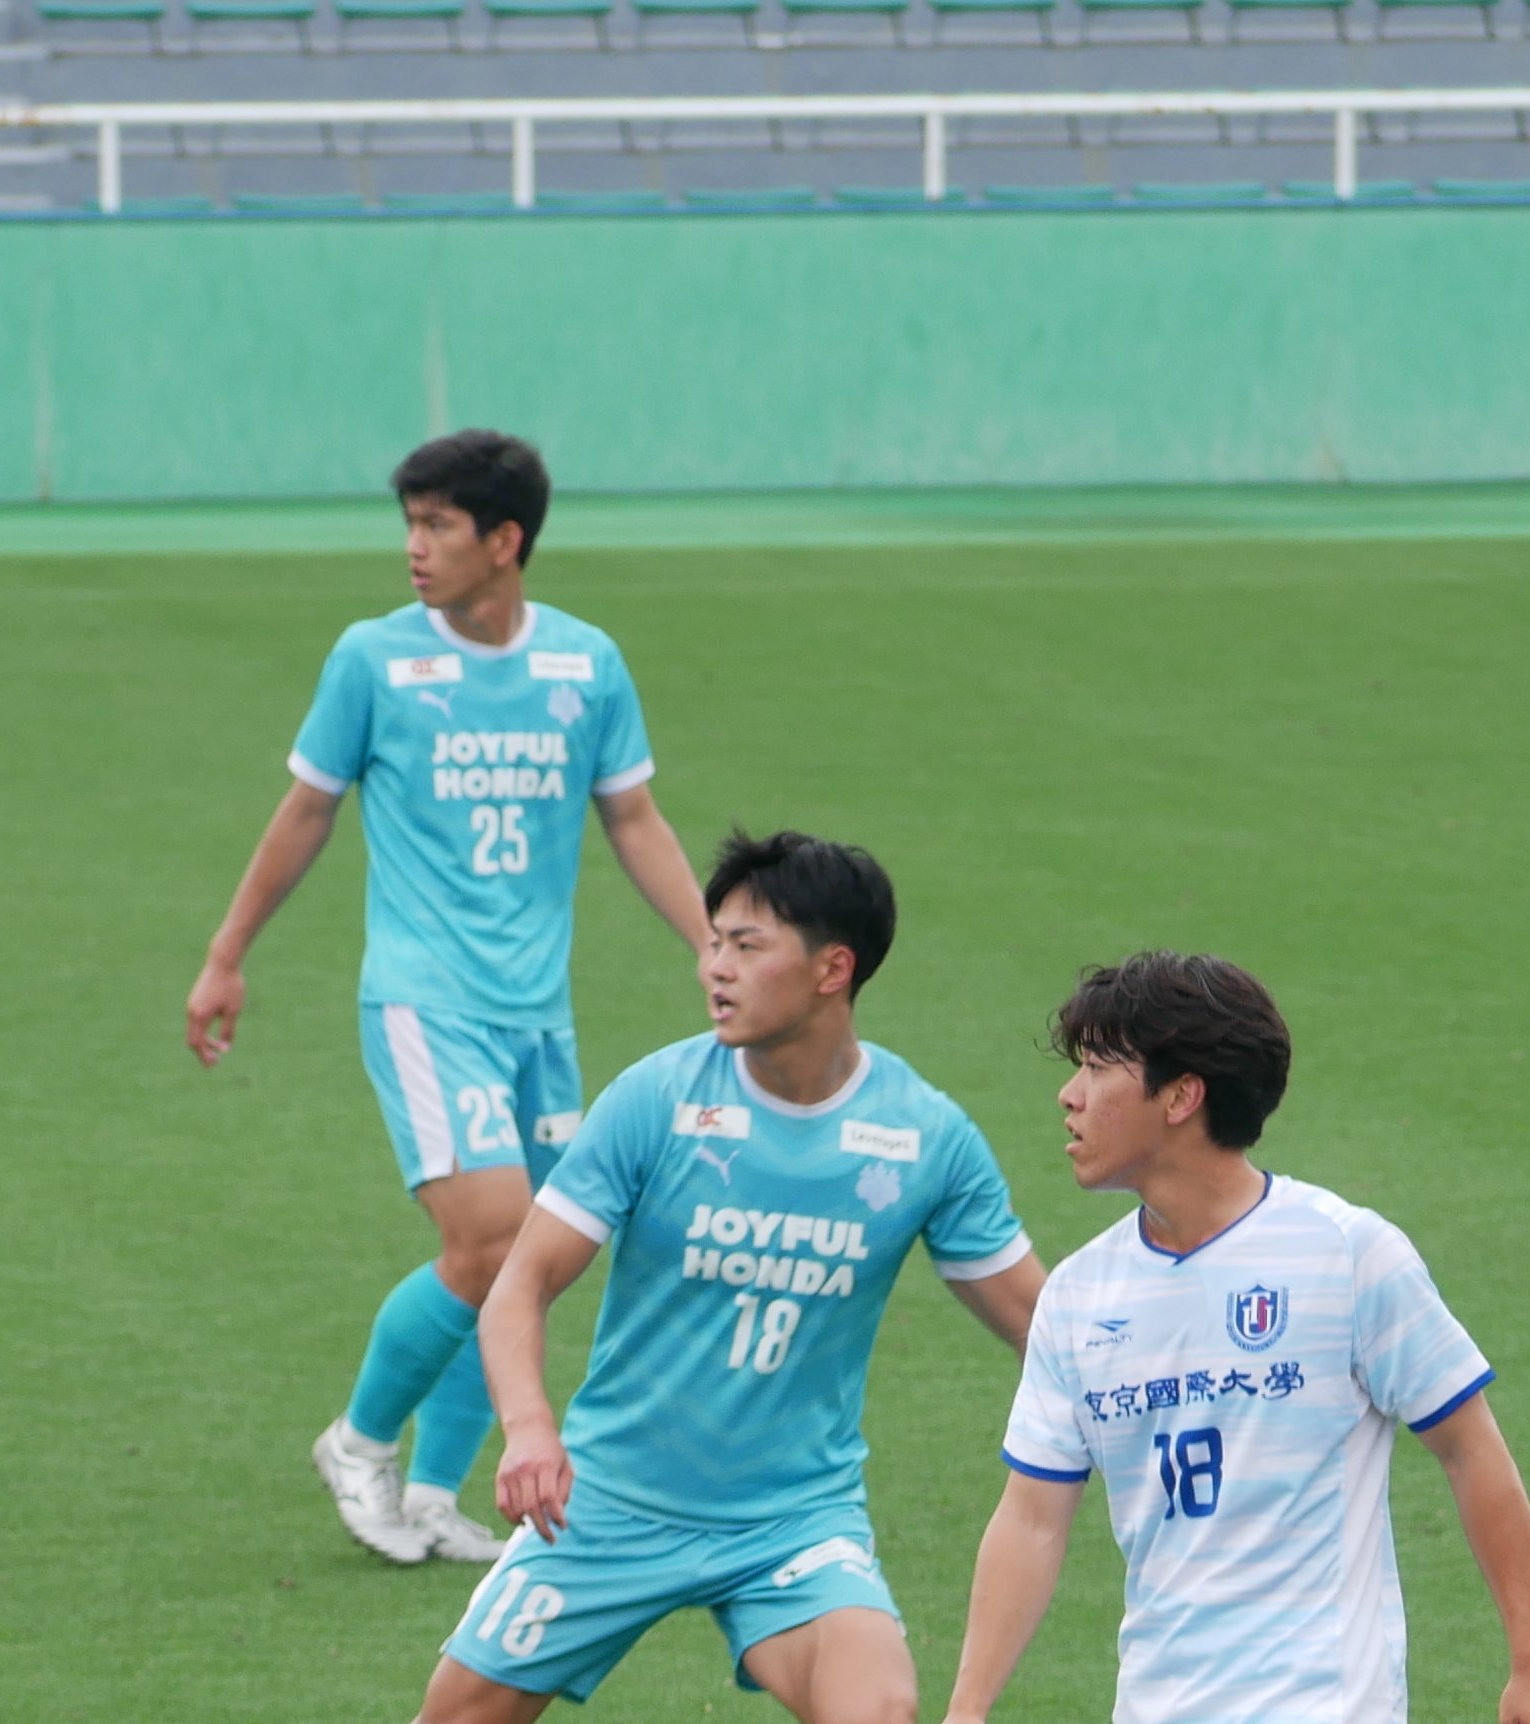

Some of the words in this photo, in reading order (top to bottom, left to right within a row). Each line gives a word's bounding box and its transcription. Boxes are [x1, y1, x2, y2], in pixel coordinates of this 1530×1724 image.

[432, 731, 568, 765] JOYFUL
[433, 767, 566, 801] HONDA
[470, 803, 530, 876] 25
[456, 1083, 520, 1153] 25
[686, 1203, 869, 1260] JOYFUL
[682, 1244, 856, 1298] HONDA
[727, 1292, 802, 1375] 18
[1154, 1426, 1224, 1520] 18
[476, 1567, 565, 1659] 18
